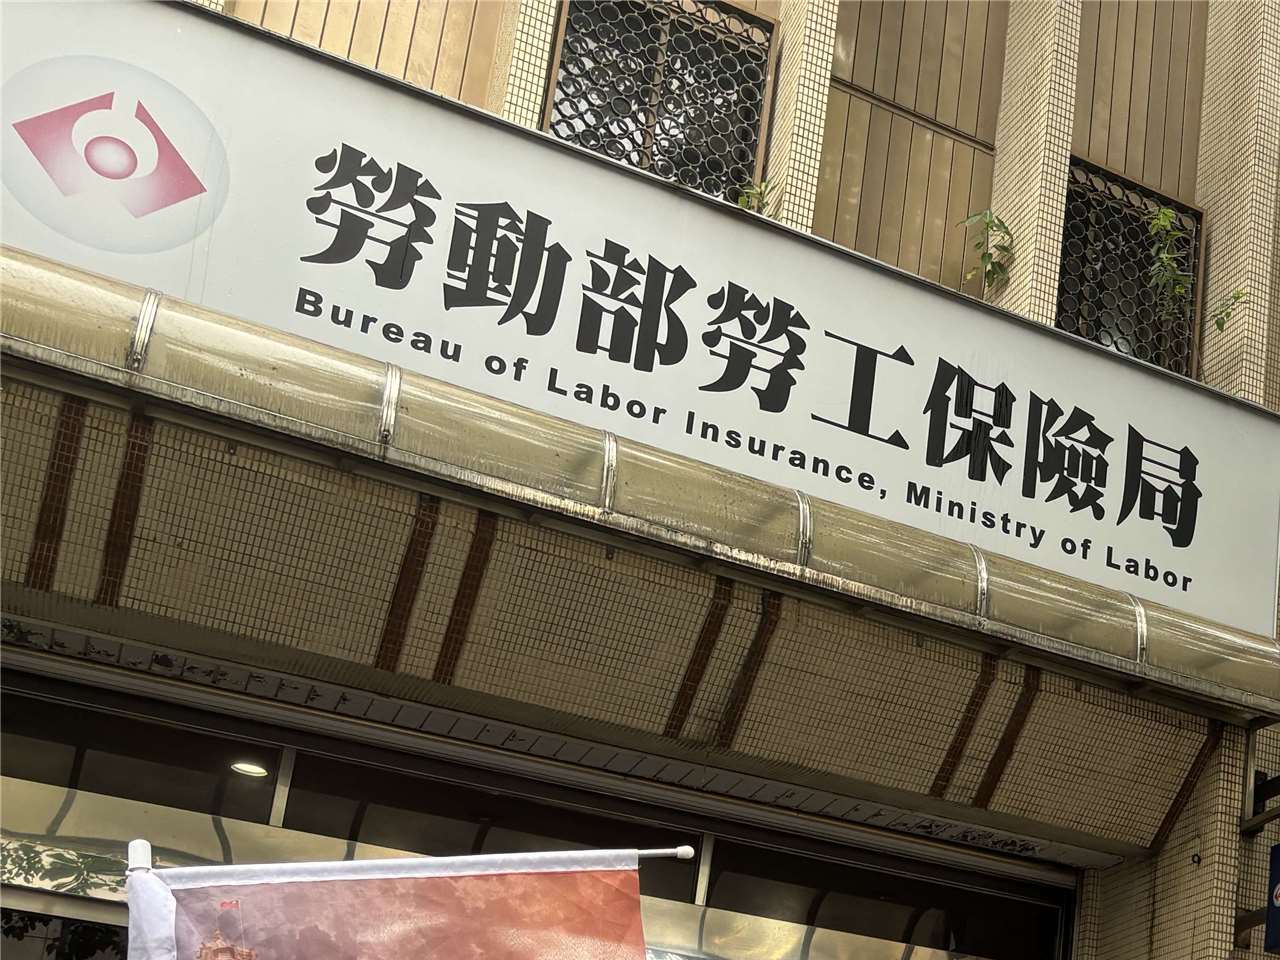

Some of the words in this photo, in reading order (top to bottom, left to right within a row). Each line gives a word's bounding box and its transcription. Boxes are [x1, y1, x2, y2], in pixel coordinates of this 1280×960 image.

[295, 288, 461, 362] Bureau
[485, 355, 529, 382] of
[548, 368, 666, 426] Labor
[685, 411, 888, 500] Insurance,
[907, 481, 1047, 549] Ministry
[1061, 535, 1092, 561] of
[1106, 546, 1193, 593] Labor
[300, 142, 1203, 548] 勞動部勞工保險局
